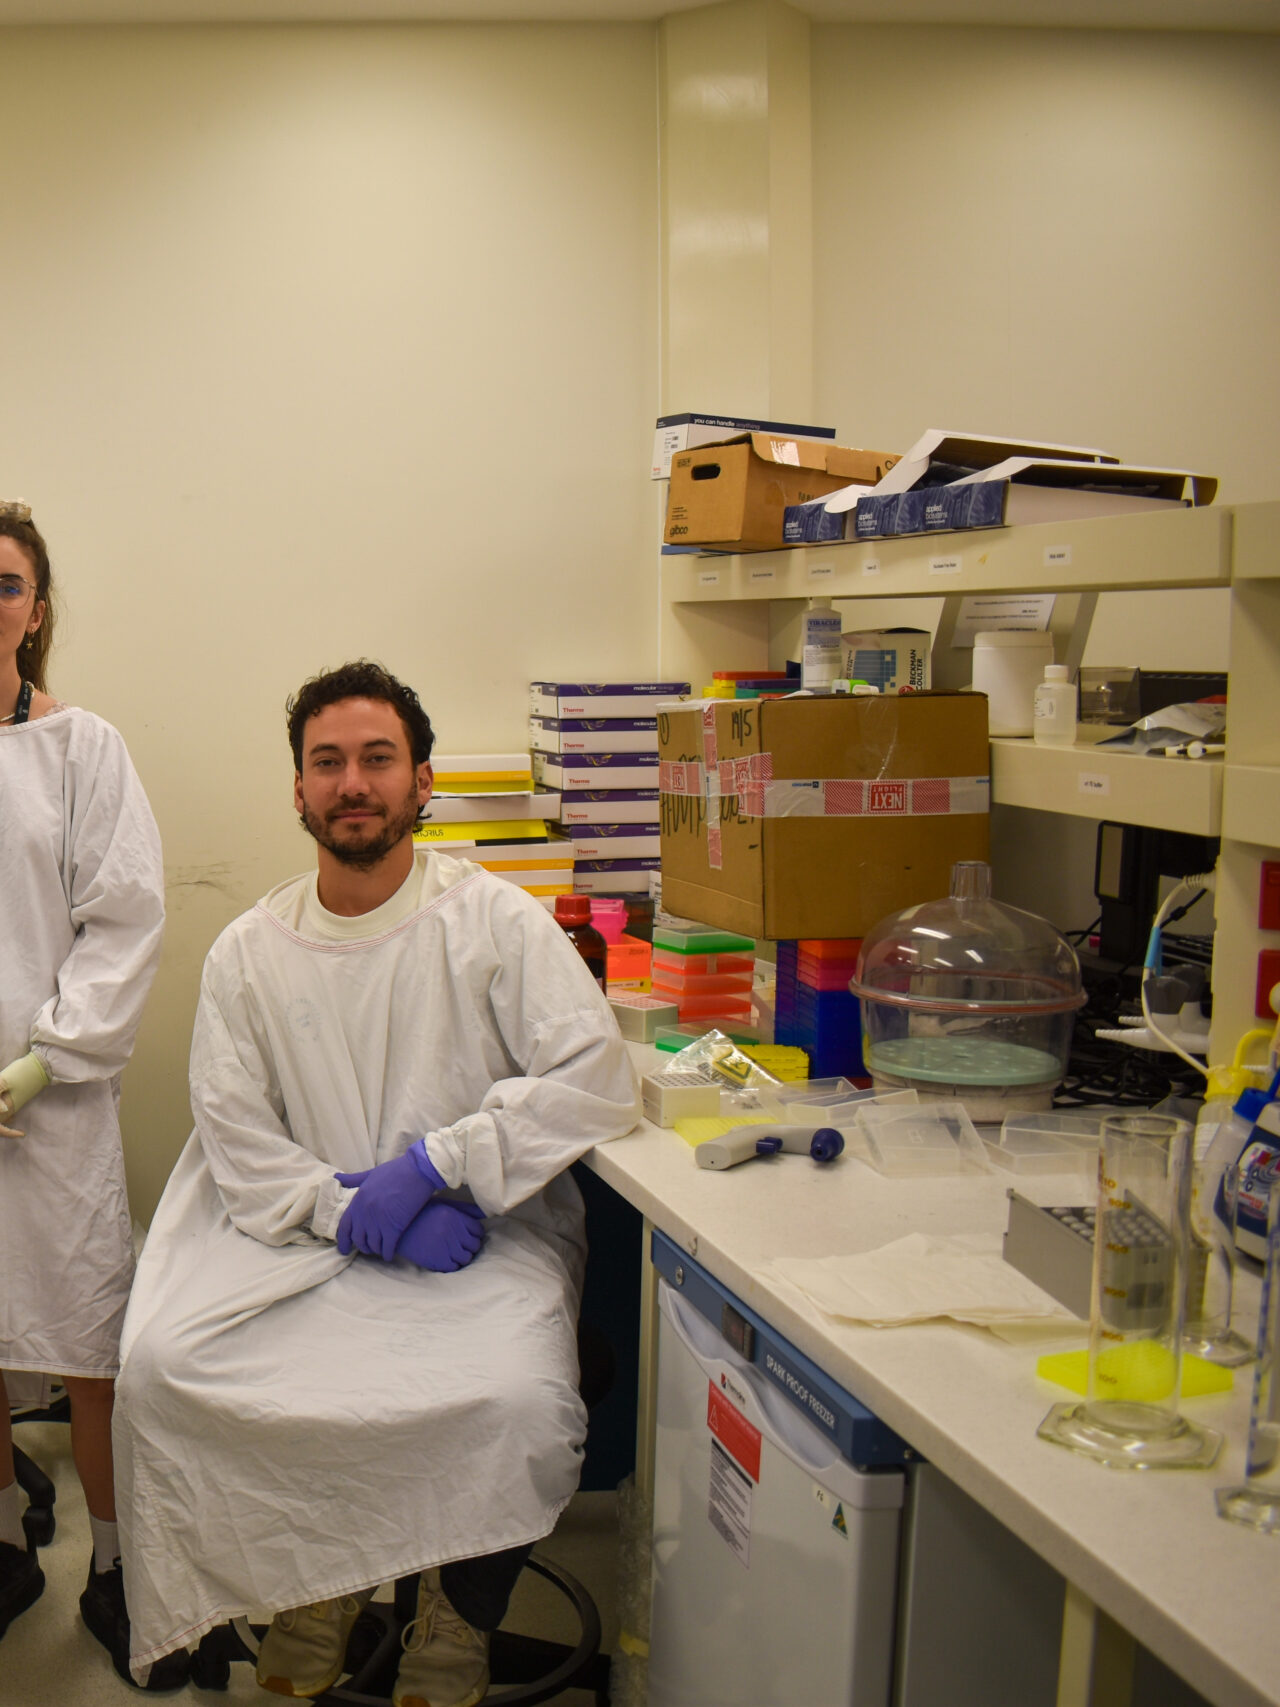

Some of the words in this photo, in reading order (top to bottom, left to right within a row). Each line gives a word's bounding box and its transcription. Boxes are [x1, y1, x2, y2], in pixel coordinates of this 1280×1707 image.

[926, 504, 942, 513] applied
[859, 513, 873, 521] applied
[670, 525, 688, 537] gibco
[872, 784, 903, 793] FLIGHT
[873, 792, 903, 809] NEXT
[766, 1354, 786, 1382] SPARK
[786, 1373, 809, 1402] PROOF
[808, 1394, 835, 1430] FREEZER
